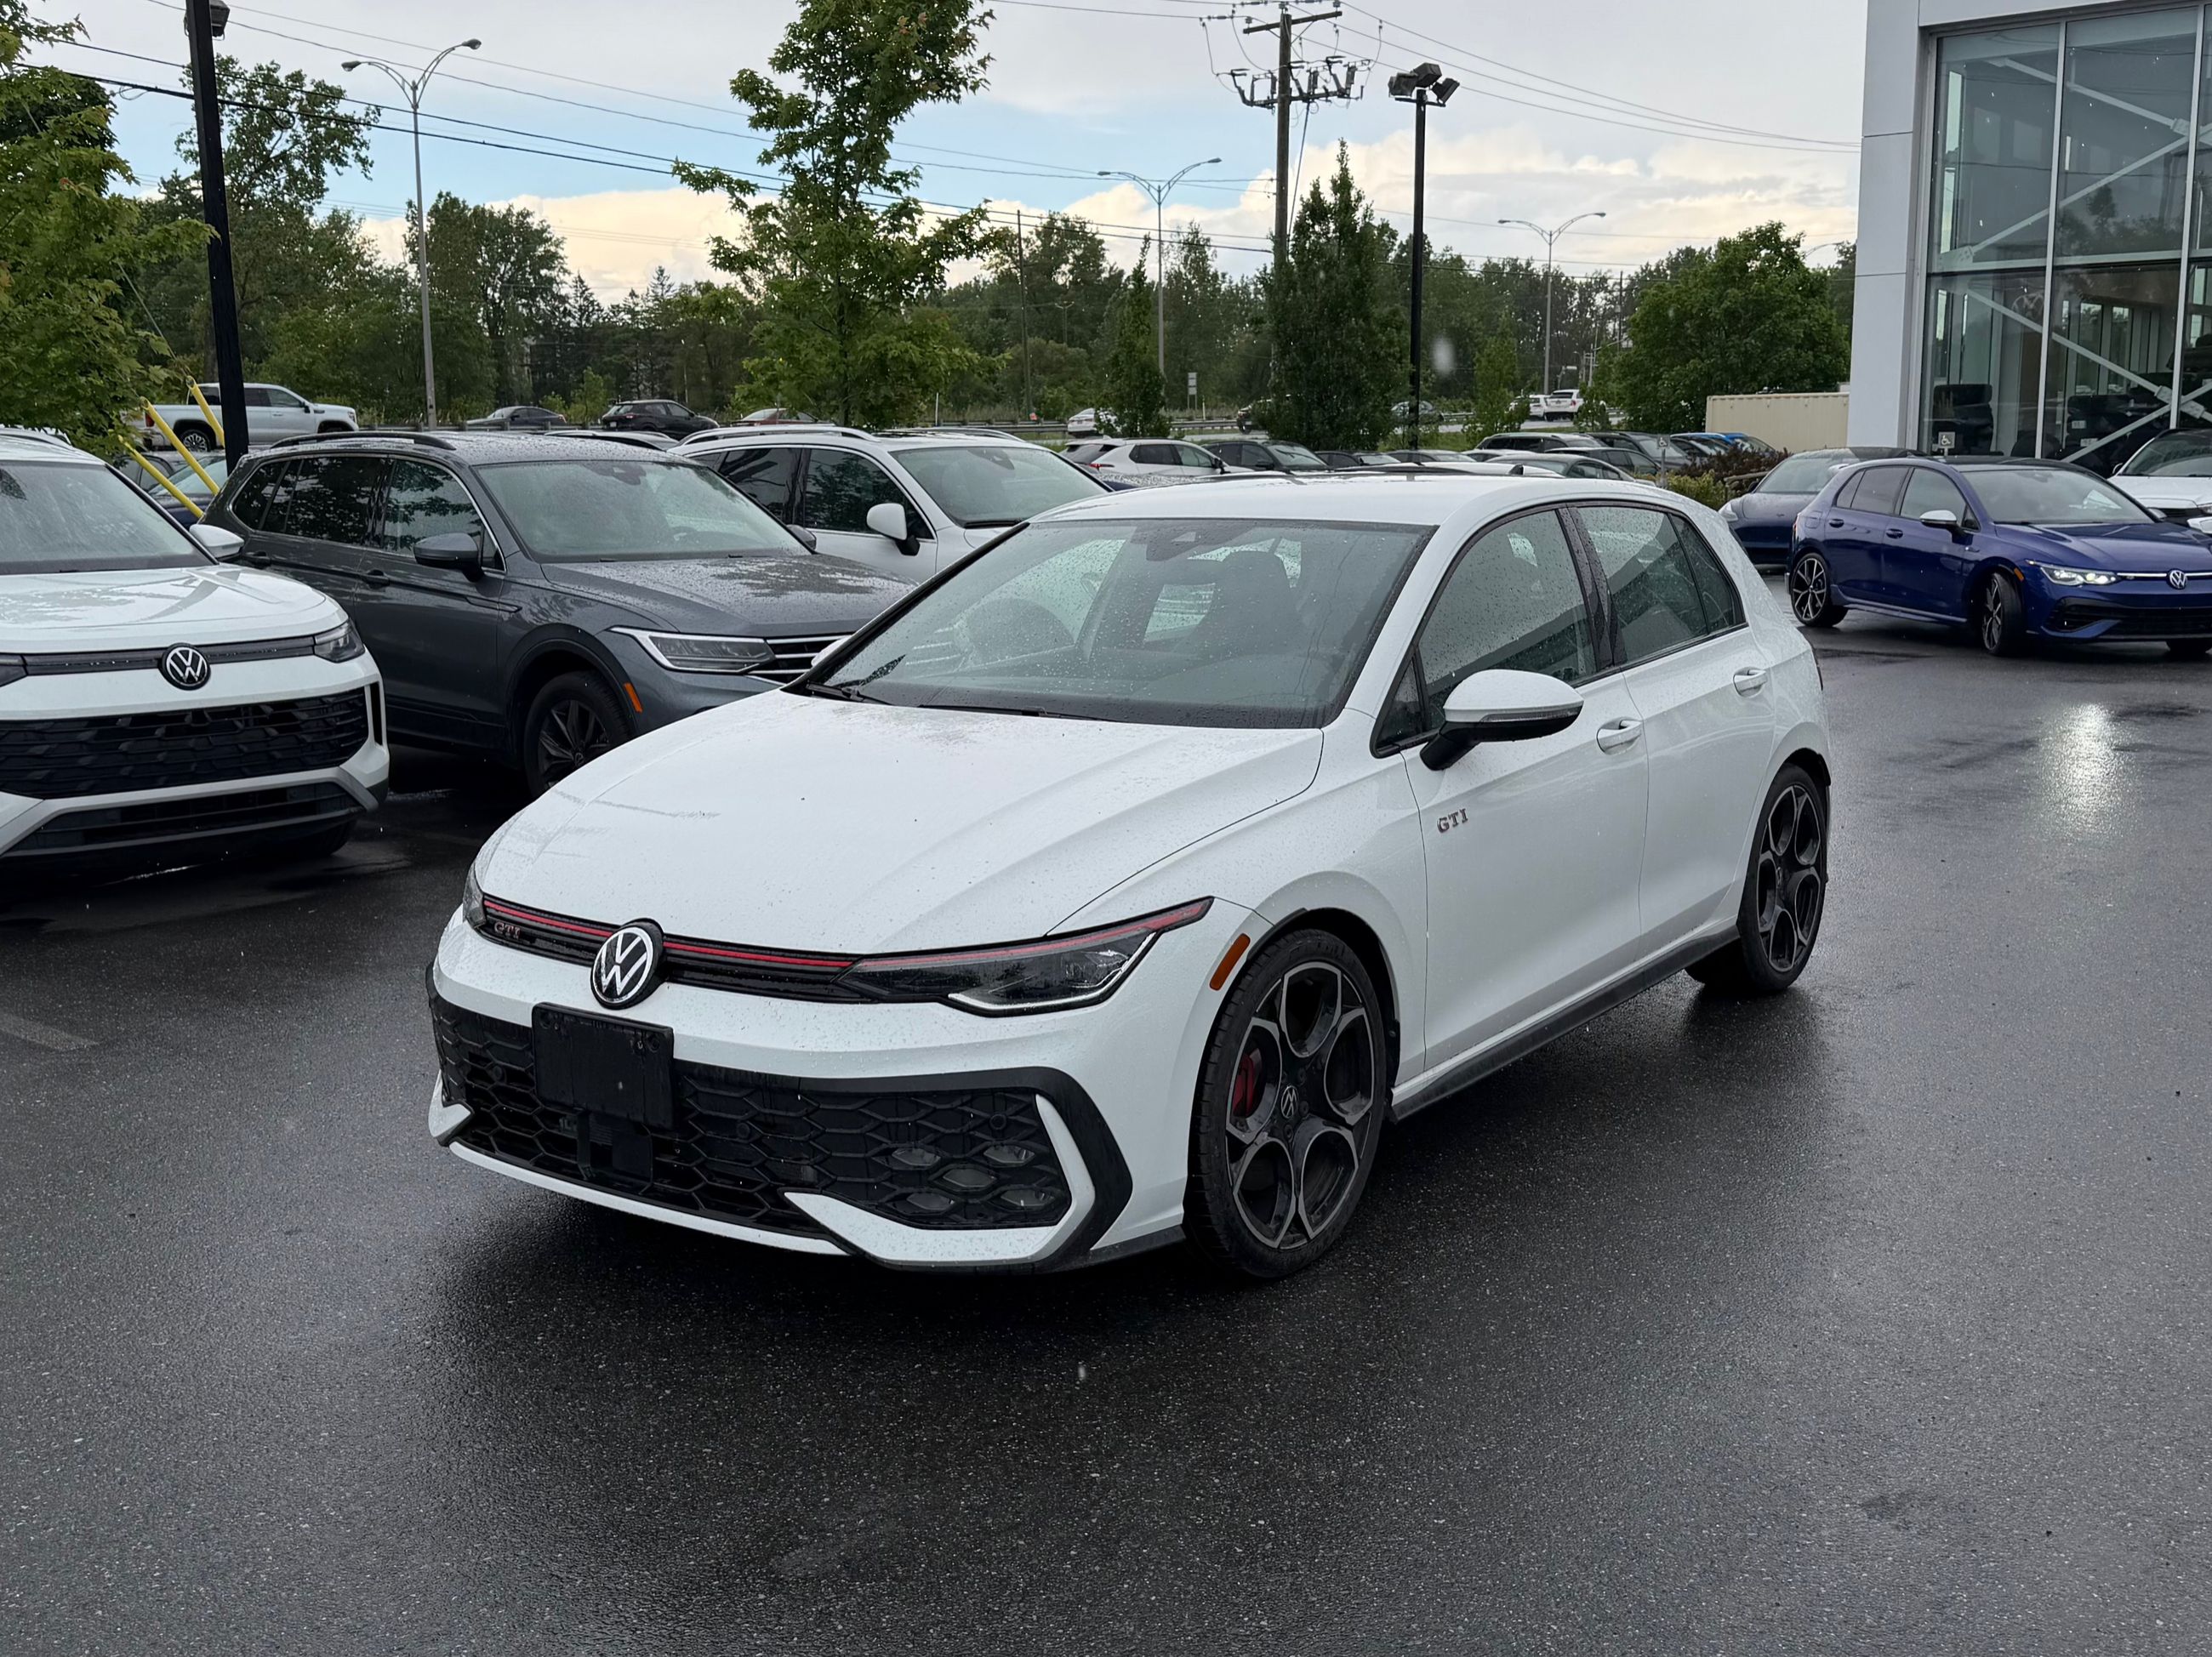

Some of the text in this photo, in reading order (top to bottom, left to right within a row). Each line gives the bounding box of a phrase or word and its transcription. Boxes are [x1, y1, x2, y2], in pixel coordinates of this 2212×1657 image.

[2169, 570, 2187, 589] VW
[168, 648, 206, 685] VW
[1437, 808, 1469, 834] GTI
[494, 921, 521, 940] GTI
[595, 928, 653, 1000] VW
